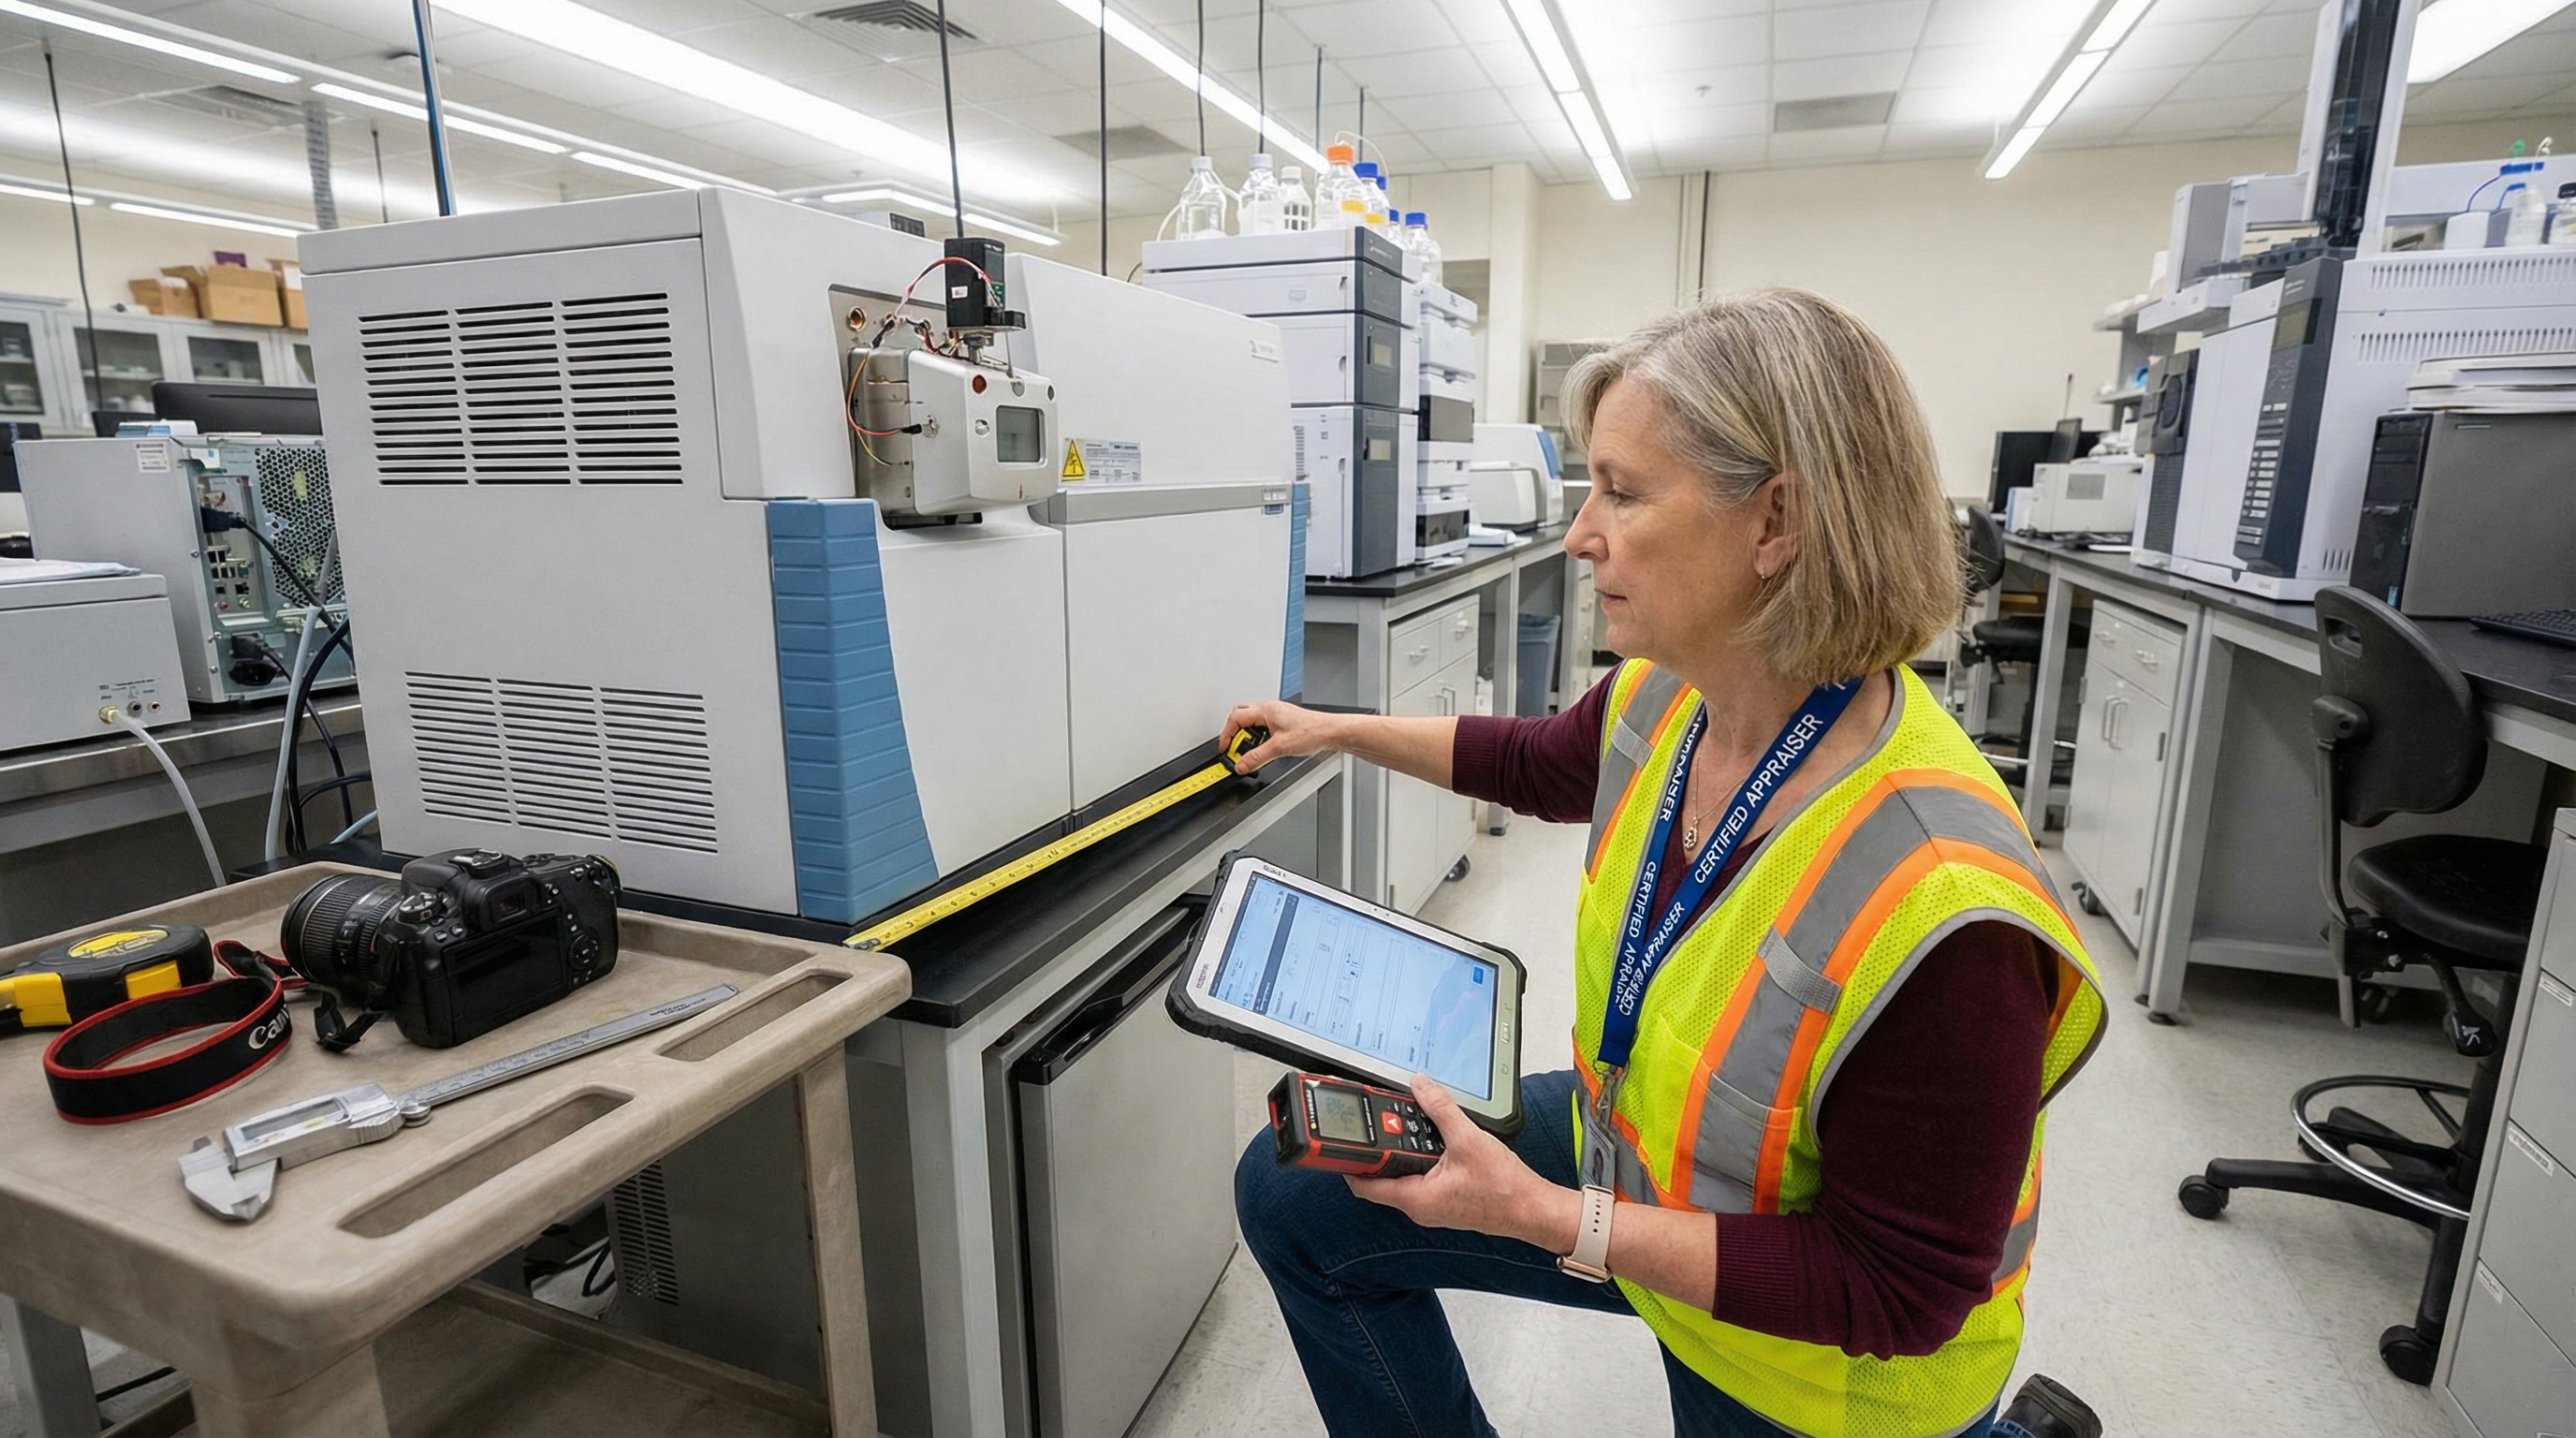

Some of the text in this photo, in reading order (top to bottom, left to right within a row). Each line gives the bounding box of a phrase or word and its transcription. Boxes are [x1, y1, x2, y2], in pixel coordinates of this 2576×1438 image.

[1694, 712, 1823, 885] CERTIFIED APPRAISER
[1629, 860, 1657, 938] CERTIFIED
